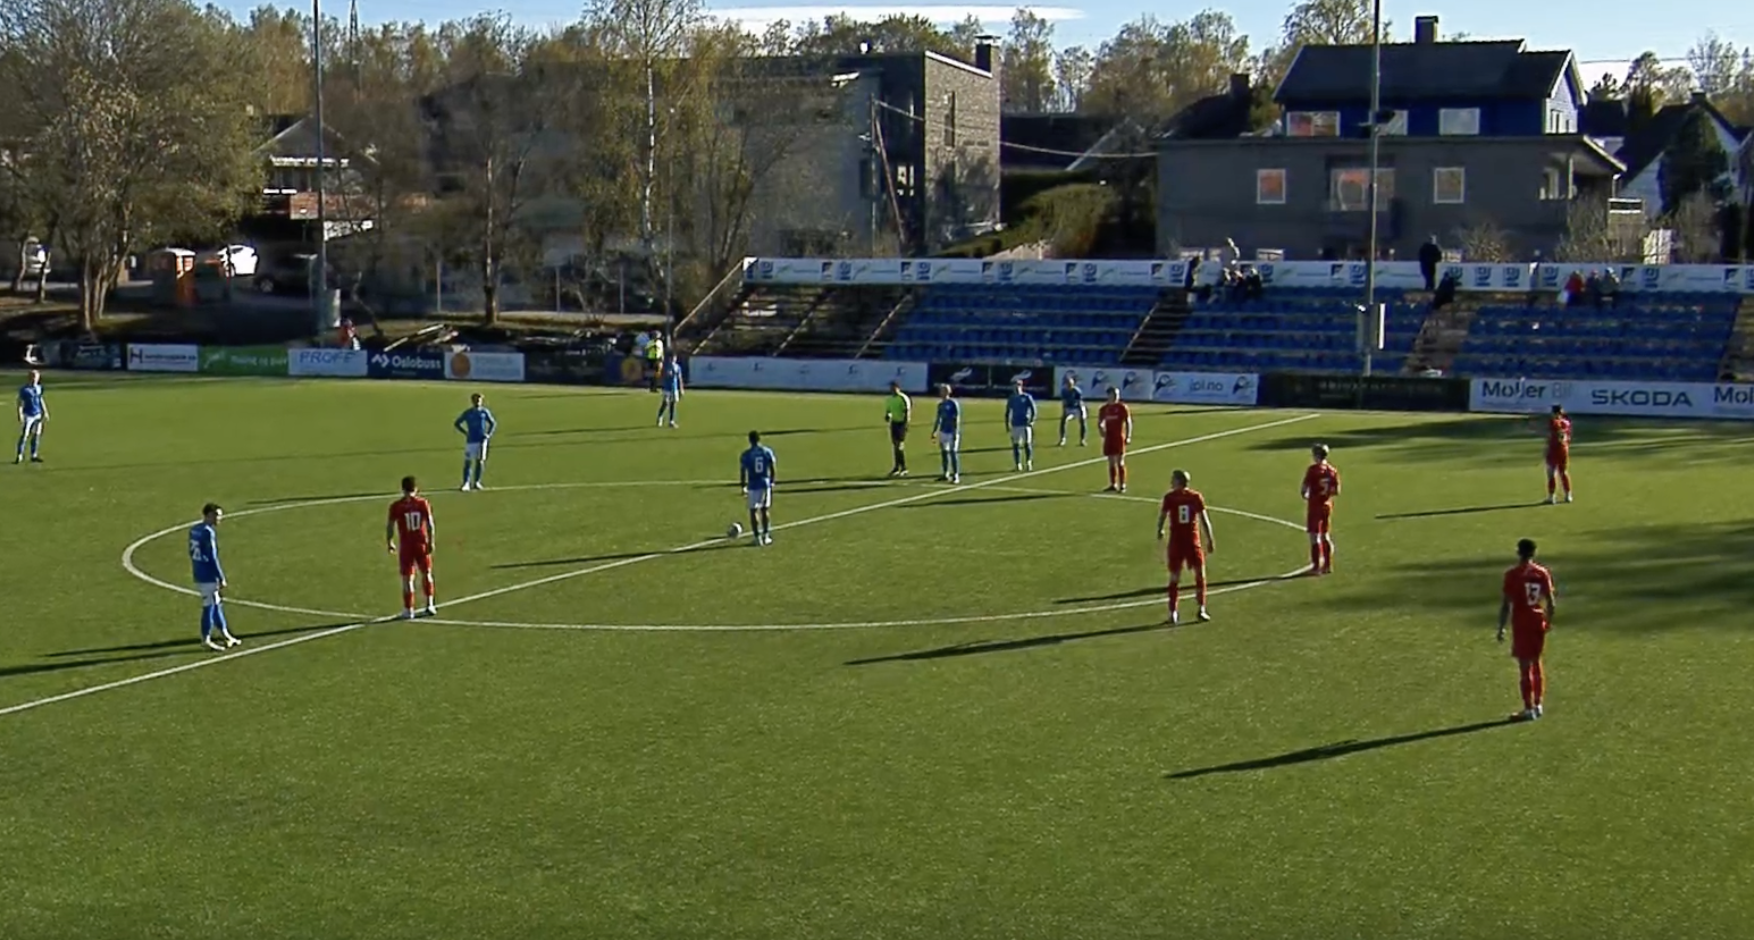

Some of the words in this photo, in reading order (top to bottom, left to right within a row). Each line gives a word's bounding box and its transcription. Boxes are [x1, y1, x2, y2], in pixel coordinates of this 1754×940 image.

[391, 355, 442, 370] Oslobuss
[1591, 389, 1692, 407] SKODA
[755, 456, 764, 473] 6
[404, 511, 421, 532] 10
[1178, 505, 1190, 524] 8
